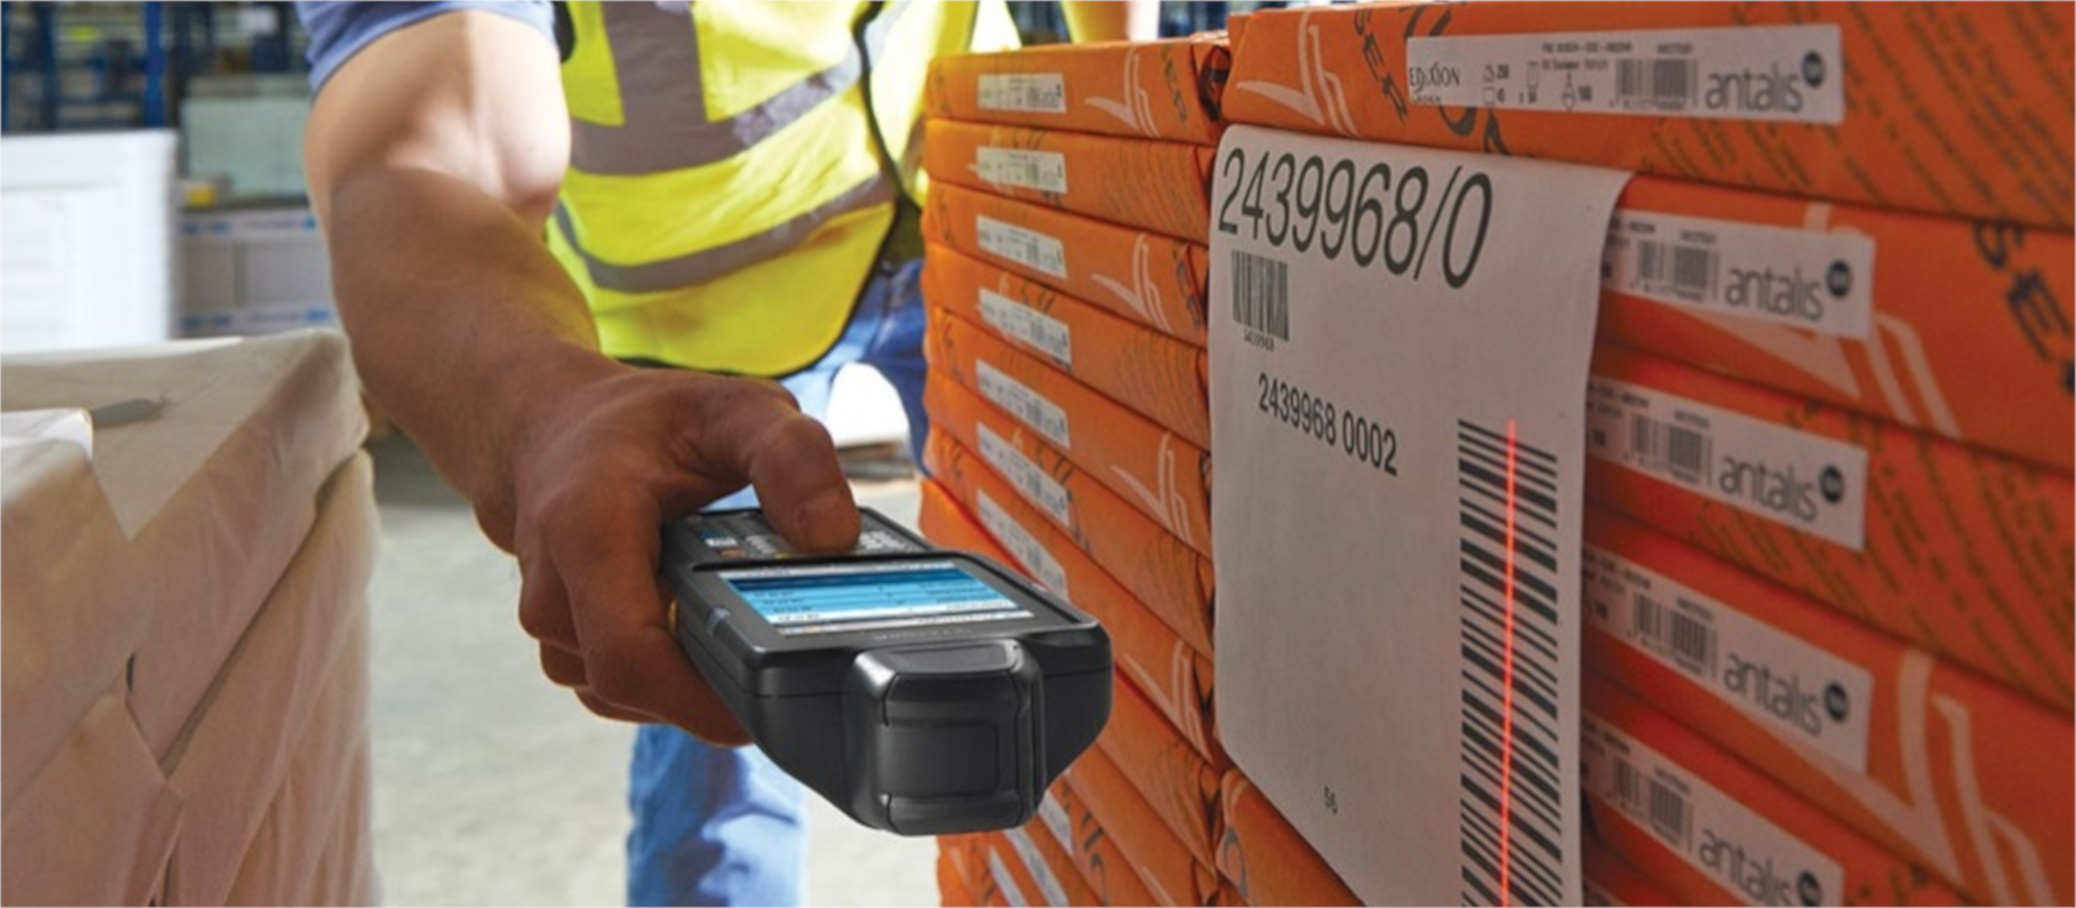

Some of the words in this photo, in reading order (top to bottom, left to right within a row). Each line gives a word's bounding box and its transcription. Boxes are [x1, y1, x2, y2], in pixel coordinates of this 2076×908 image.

[1705, 61, 1804, 113] antalis
[1218, 147, 1493, 290] 2439968/0
[1724, 264, 1825, 322] antalis
[1258, 371, 1337, 447] 2439968
[1342, 410, 1398, 478] 0002
[1718, 455, 1819, 523] antalis
[1722, 652, 1823, 738] antalis
